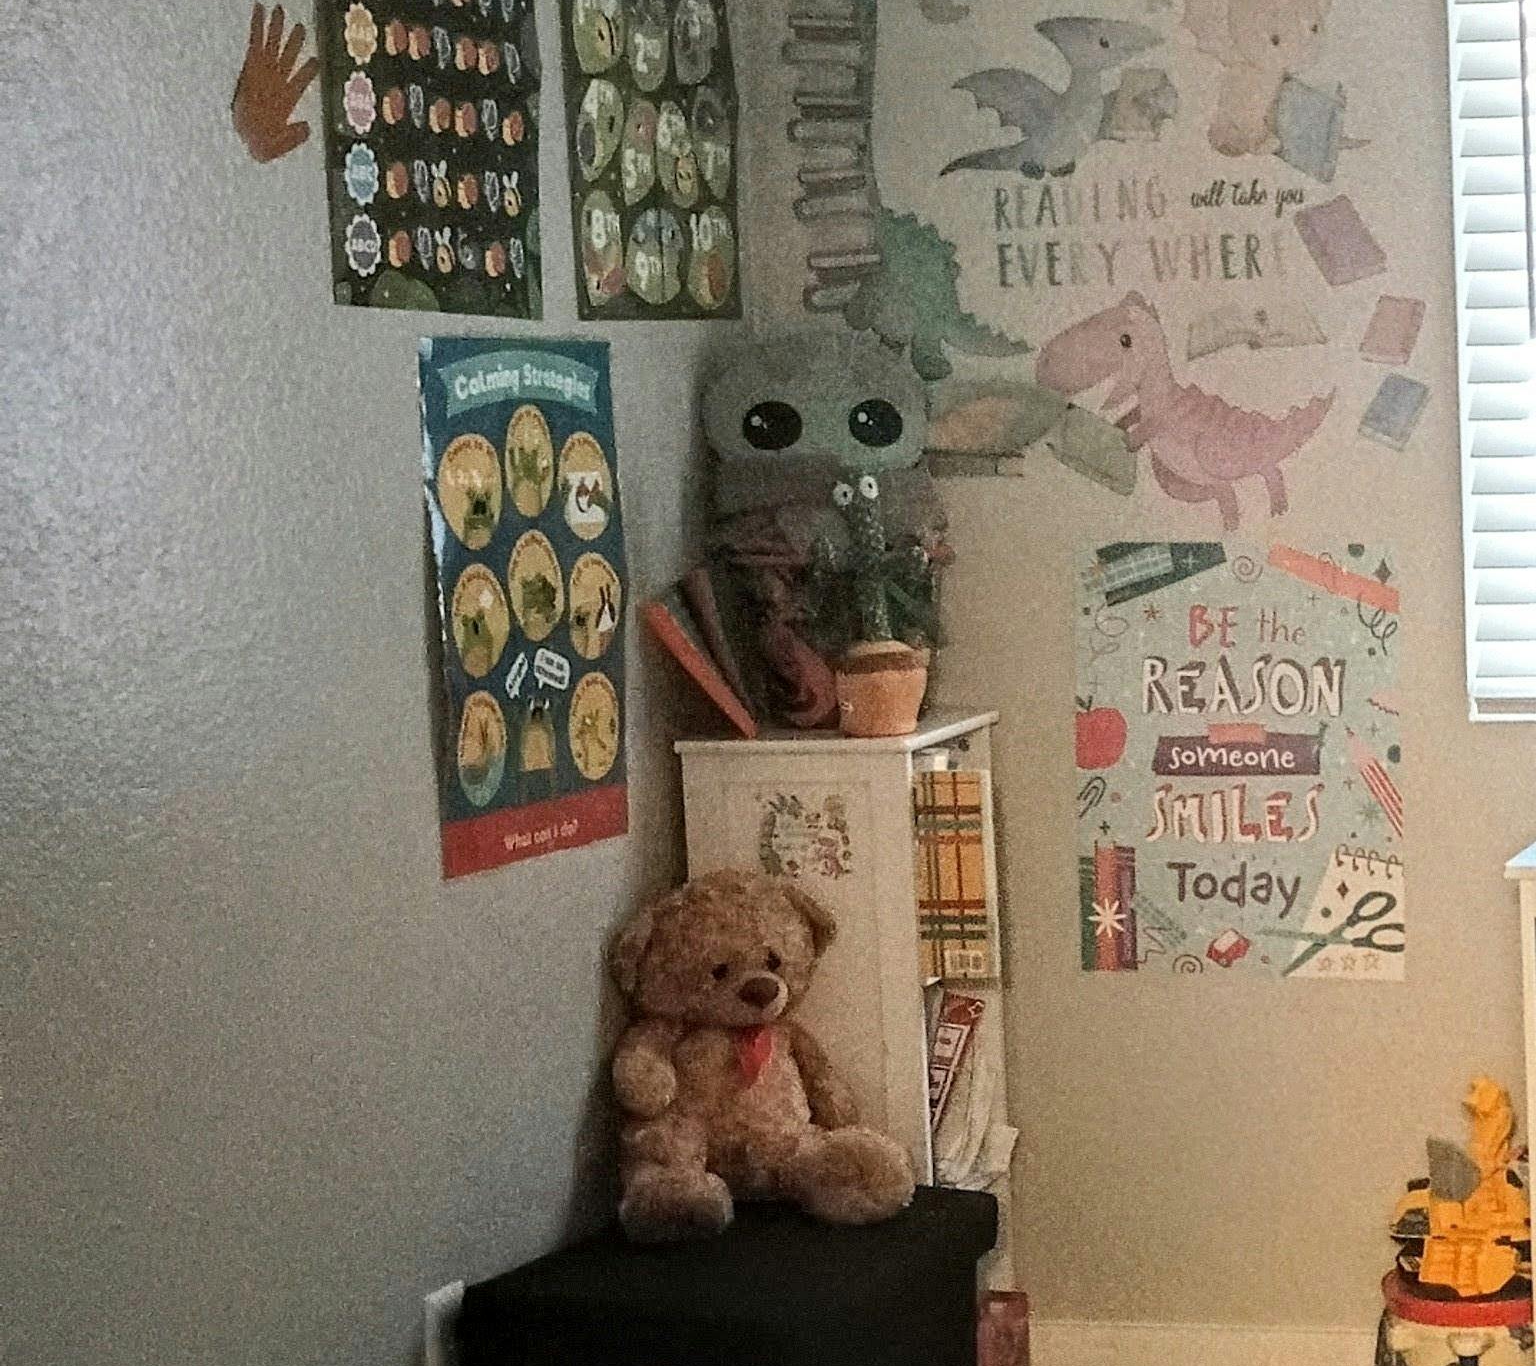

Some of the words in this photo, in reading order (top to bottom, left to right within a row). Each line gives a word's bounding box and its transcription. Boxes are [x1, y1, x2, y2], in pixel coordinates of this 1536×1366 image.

[994, 178, 1167, 232] READING
[1190, 180, 1226, 209] will
[1274, 188, 1304, 219] you
[455, 363, 520, 400] Calming
[522, 363, 590, 401] Strategies
[1188, 604, 1239, 650] BE
[1256, 607, 1307, 646] the
[1140, 653, 1347, 719] REASON
[1168, 741, 1296, 770] someone
[1145, 782, 1325, 844] SMILES
[1167, 860, 1301, 919] Today
